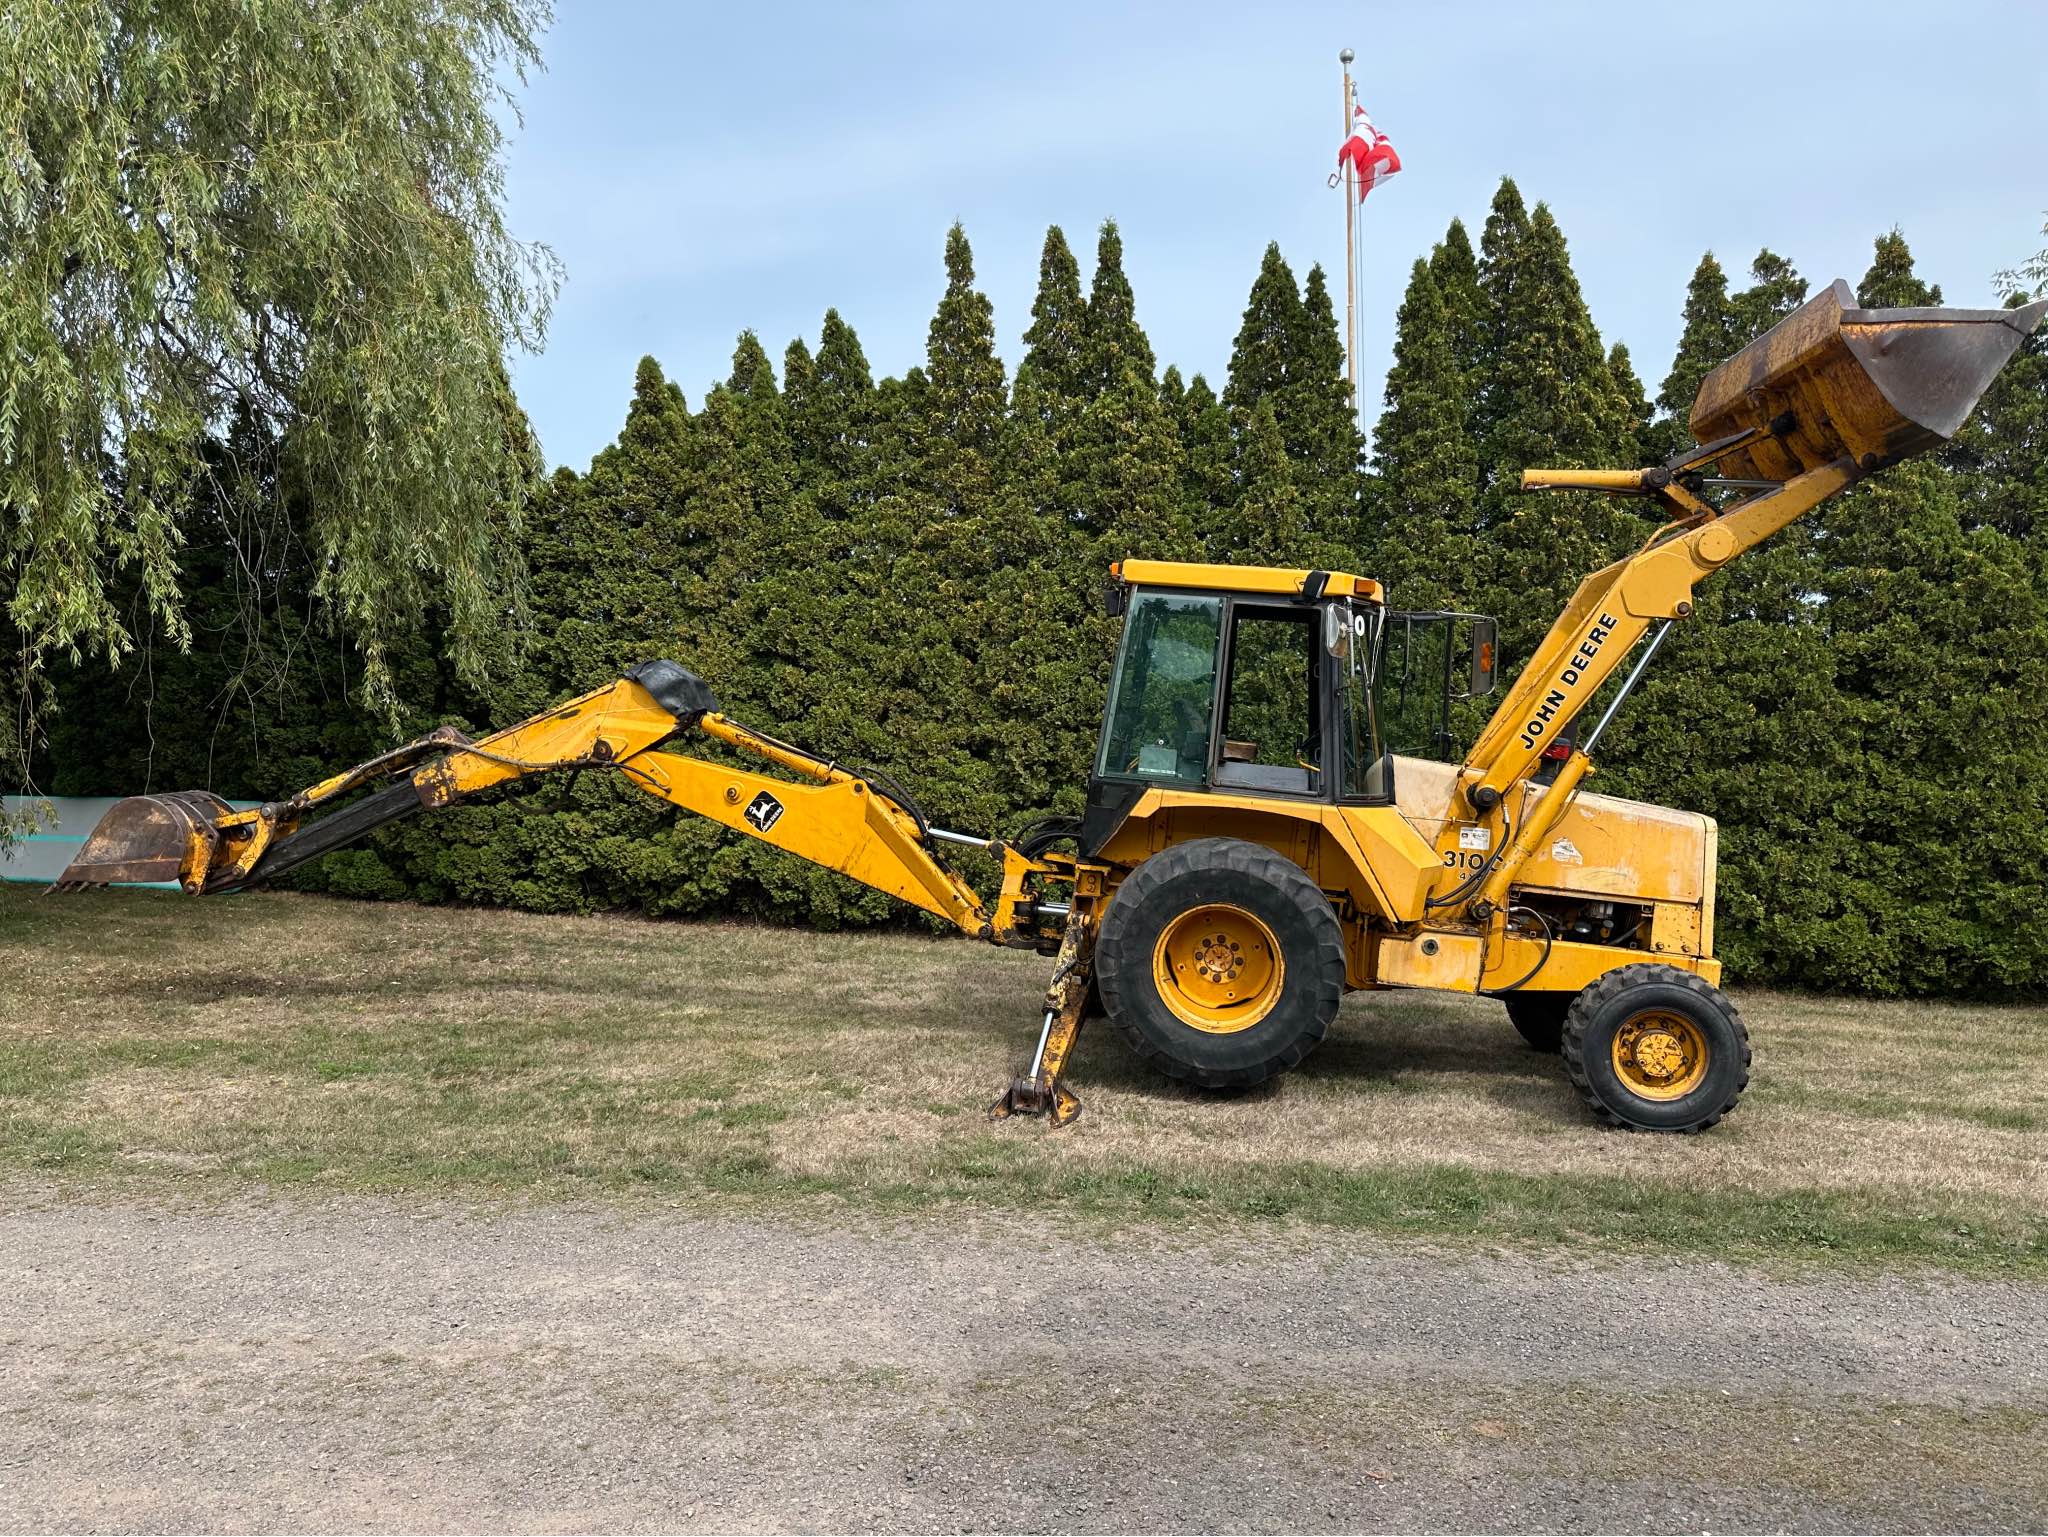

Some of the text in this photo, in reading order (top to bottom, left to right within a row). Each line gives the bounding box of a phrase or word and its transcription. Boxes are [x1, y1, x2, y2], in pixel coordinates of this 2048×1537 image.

[1520, 613, 1618, 750] JOHN DEERE
[762, 819, 773, 832] JOHN
